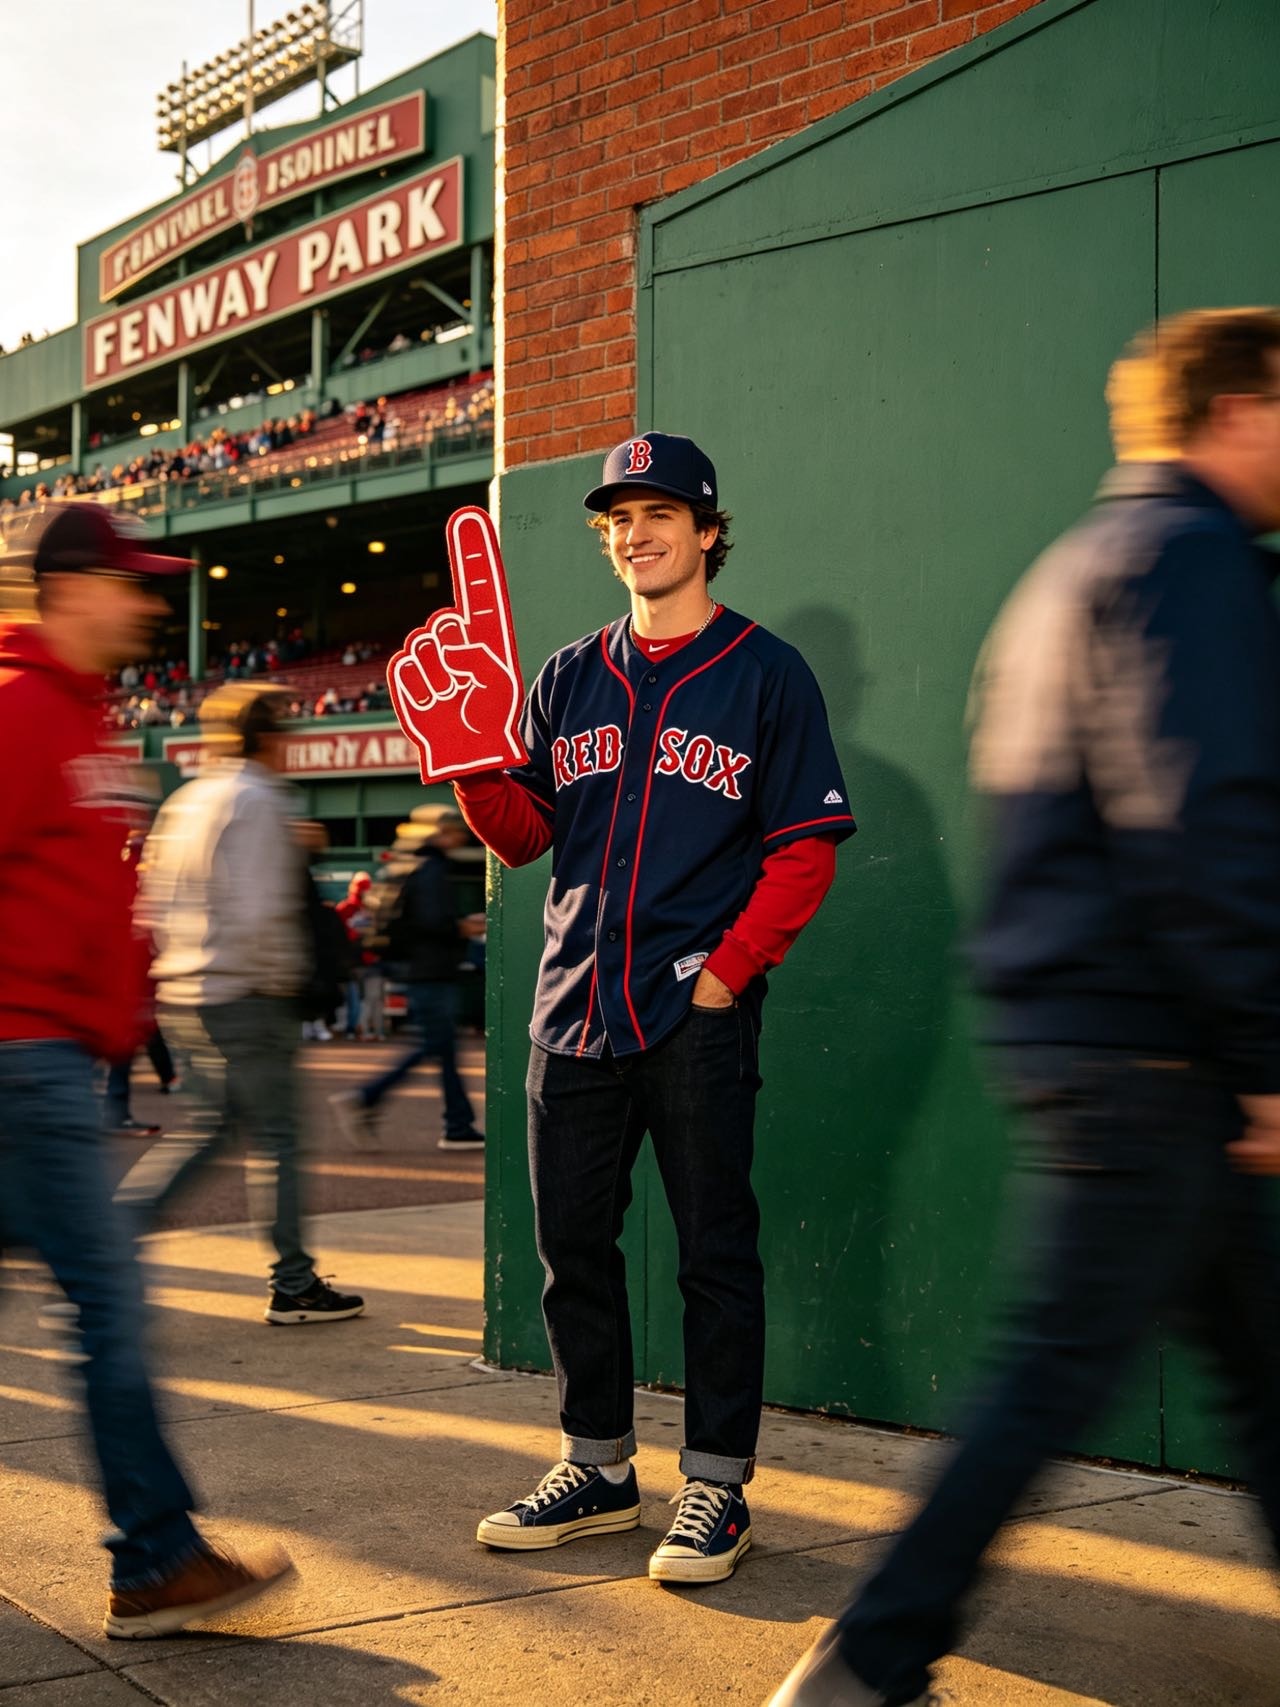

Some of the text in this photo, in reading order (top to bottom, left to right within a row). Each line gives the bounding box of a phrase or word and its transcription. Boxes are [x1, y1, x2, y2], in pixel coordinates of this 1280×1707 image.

[93, 251, 279, 376] FENWAY
[298, 178, 445, 293] PARK
[626, 440, 653, 474] B
[551, 724, 752, 801] RED SOX
